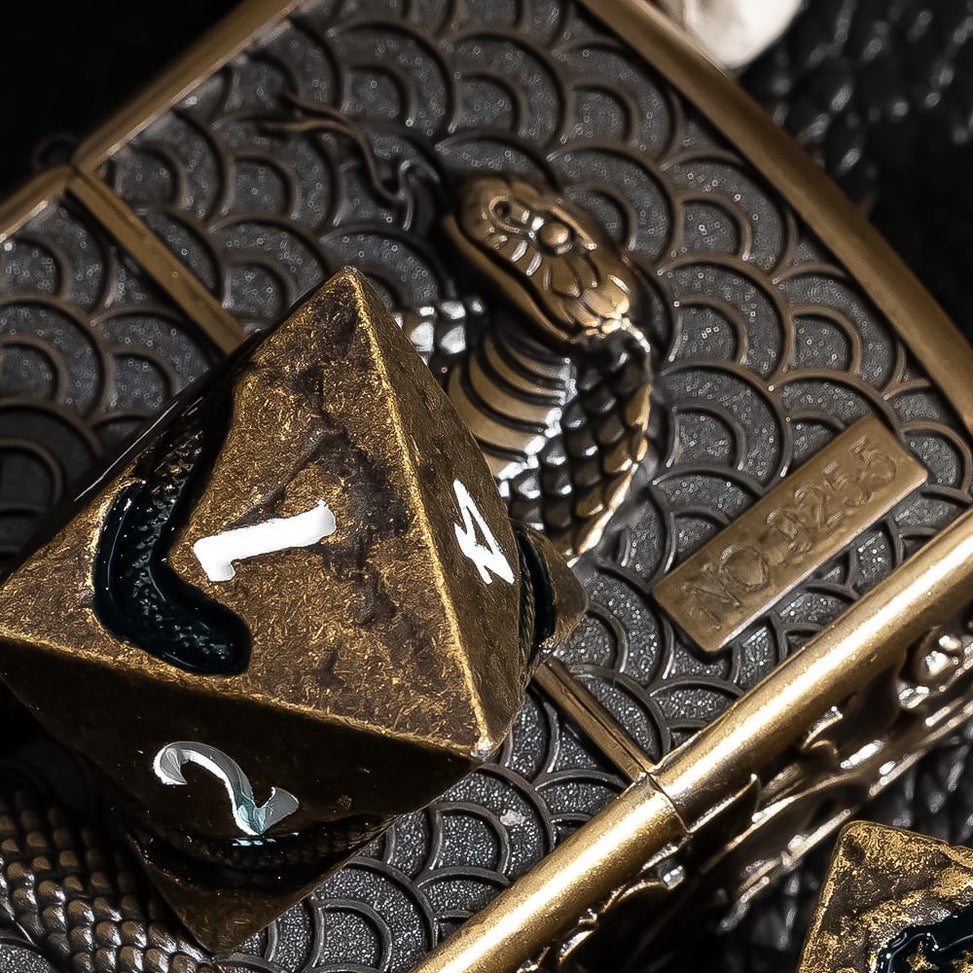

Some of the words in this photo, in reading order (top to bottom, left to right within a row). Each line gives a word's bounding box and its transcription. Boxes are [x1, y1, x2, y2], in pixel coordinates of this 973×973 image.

[191, 499, 336, 581] 1
[454, 478, 514, 584] 4
[152, 741, 299, 838] 2
